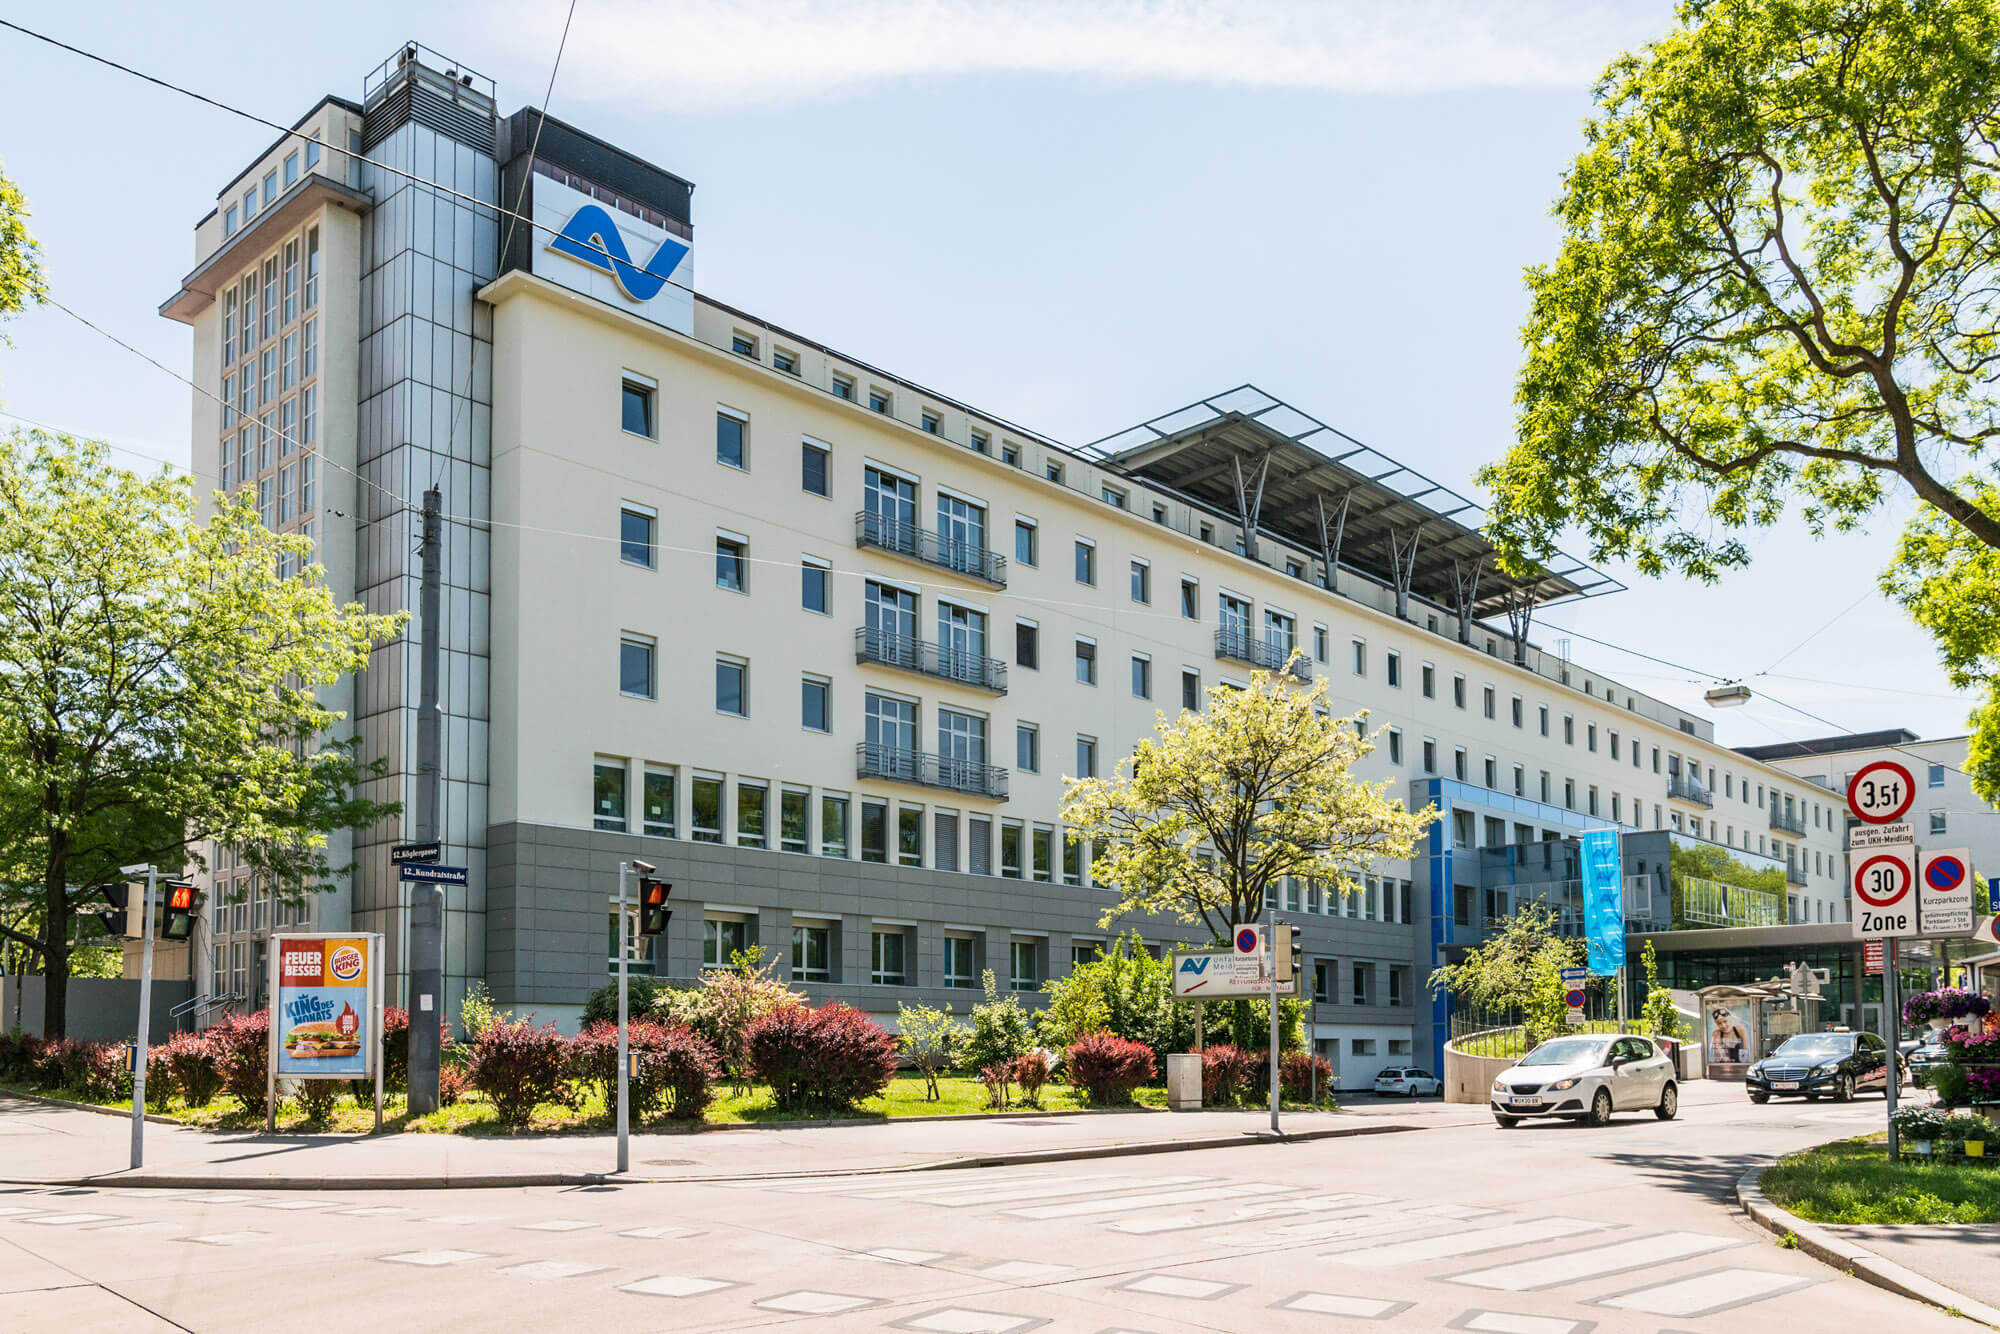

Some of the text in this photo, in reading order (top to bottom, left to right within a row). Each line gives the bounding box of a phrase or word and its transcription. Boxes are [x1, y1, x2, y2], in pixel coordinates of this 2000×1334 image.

[1862, 781, 1899, 808] 3,5t
[1854, 825, 1909, 838] ausgen. Zufahrt
[1867, 834, 1914, 845] UKH-Meidling
[1871, 868, 1894, 893] 30
[1923, 896, 1969, 905] Kurzparkzone
[1861, 912, 1907, 932] Zone
[285, 951, 322, 965] FEUER
[334, 953, 359, 964] BURGER
[285, 965, 321, 976] BESSER
[335, 959, 360, 973] KING
[284, 996, 335, 1018] KING DES
[293, 1009, 332, 1025] MONATS
